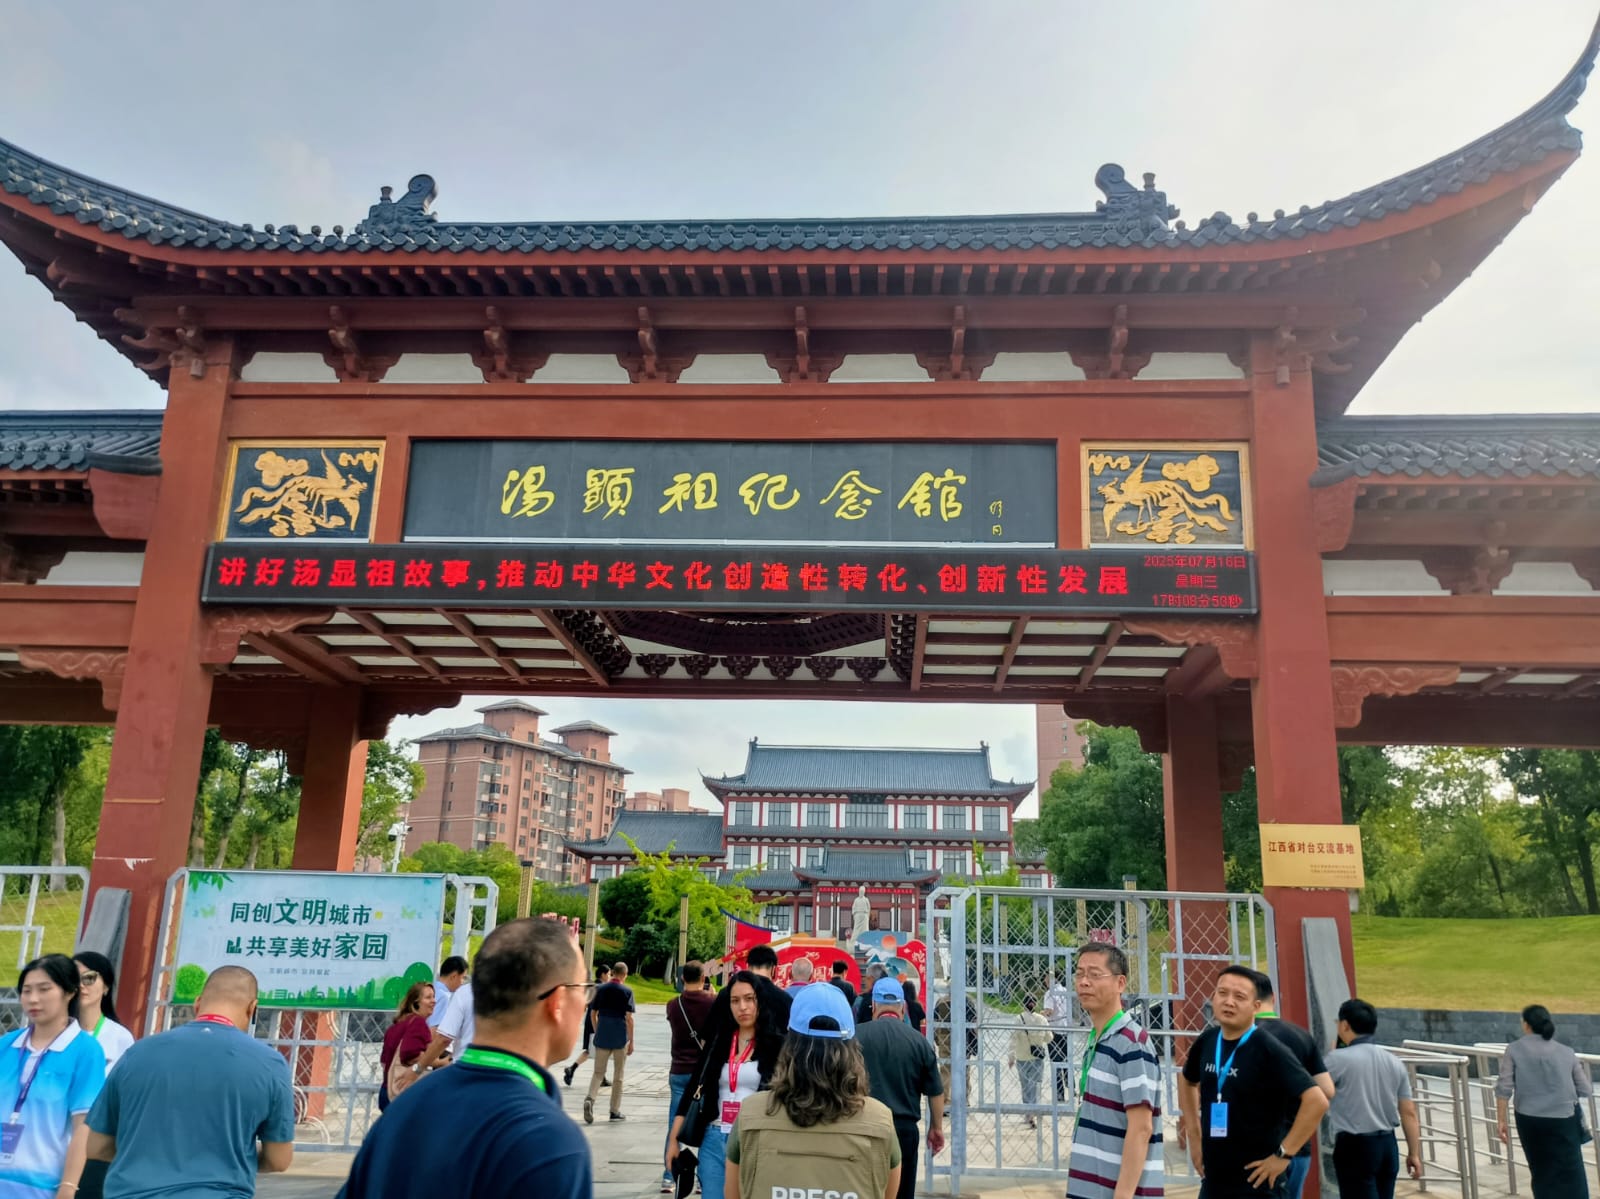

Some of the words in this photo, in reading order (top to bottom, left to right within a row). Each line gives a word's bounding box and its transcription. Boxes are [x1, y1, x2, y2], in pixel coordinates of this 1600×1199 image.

[1144, 555, 1246, 569] 2025年07月16日
[1176, 574, 1217, 589] 星期三
[1268, 841, 1355, 855] 江西省对台交流基地
[230, 898, 372, 926] 同创文明城市
[246, 932, 388, 960] 共享美好家园
